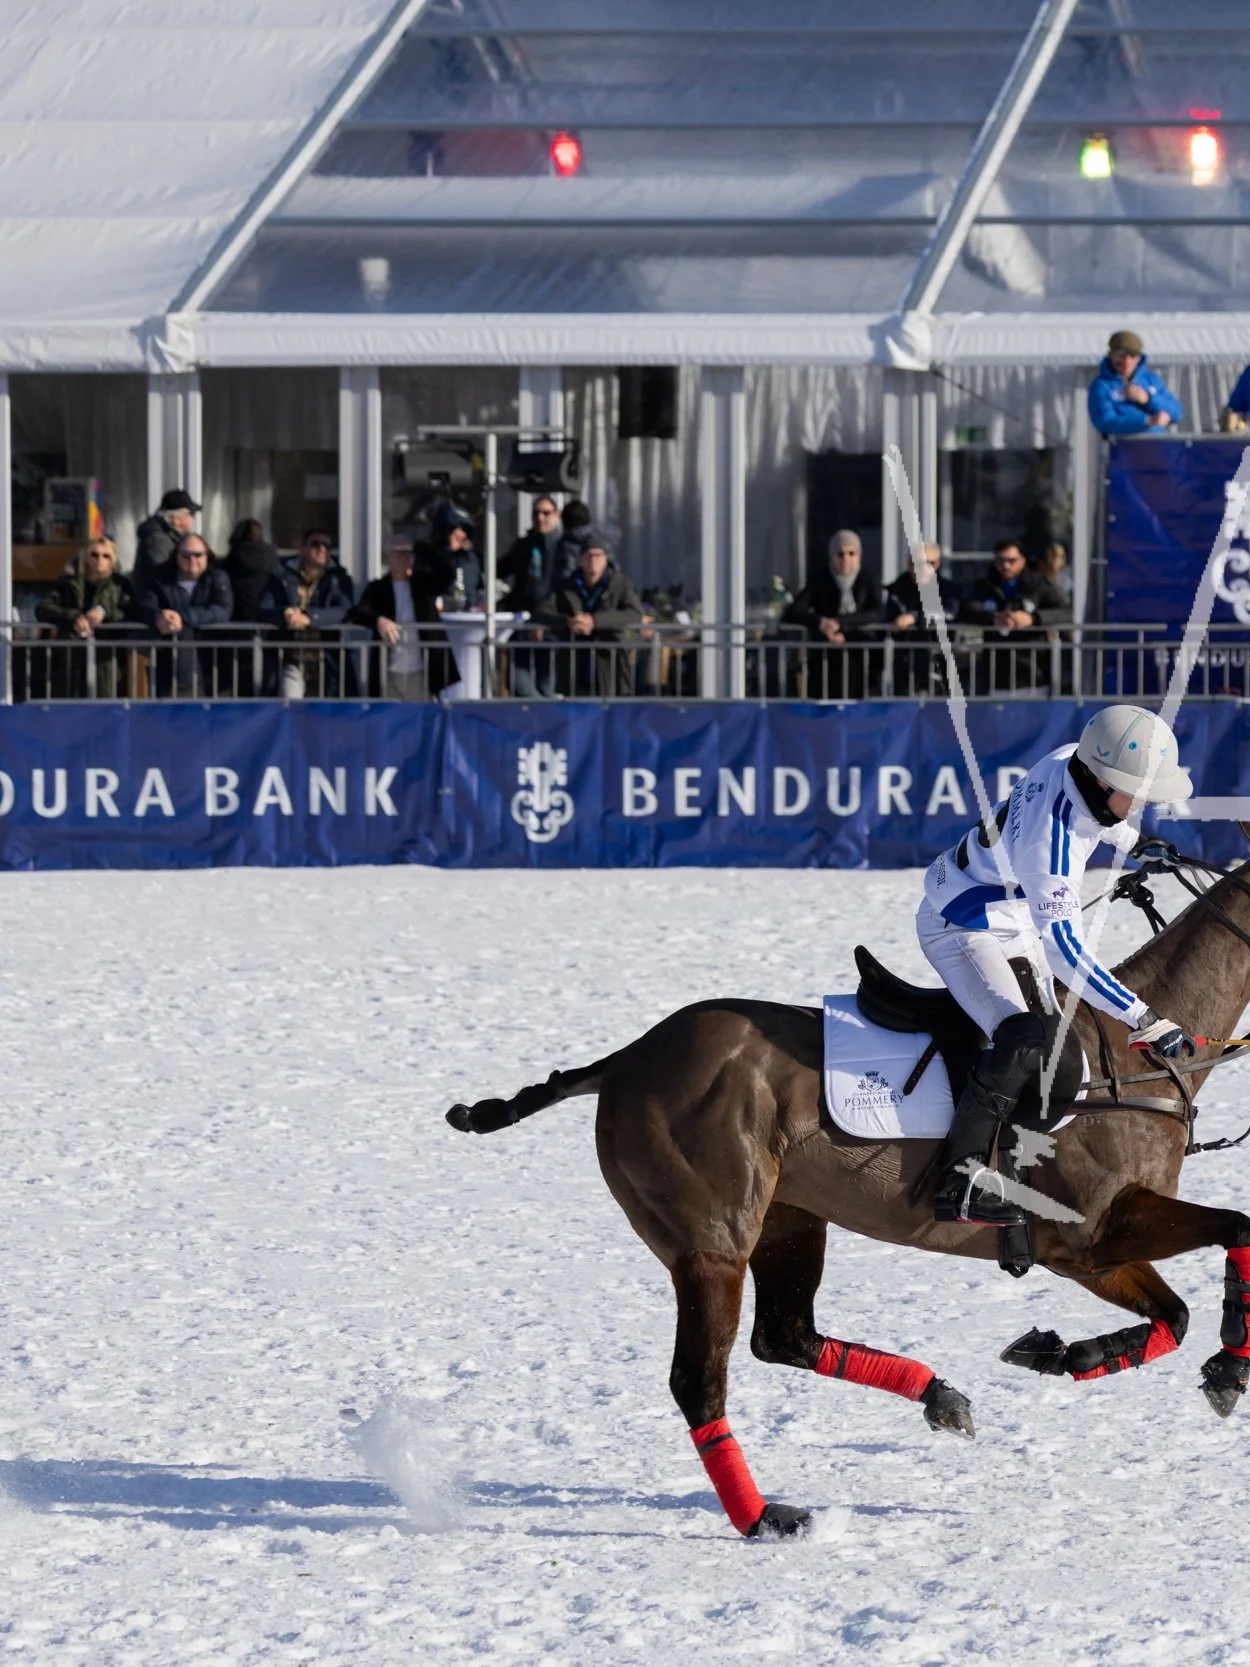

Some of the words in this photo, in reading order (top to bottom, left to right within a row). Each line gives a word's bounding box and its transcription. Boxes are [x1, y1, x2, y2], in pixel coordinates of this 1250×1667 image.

[204, 766, 400, 817] BANK
[621, 766, 968, 817] BENDURA
[1038, 900, 1080, 911] LIFESTYLE
[1051, 908, 1073, 918] POLO
[844, 1094, 905, 1107] POMMERY
